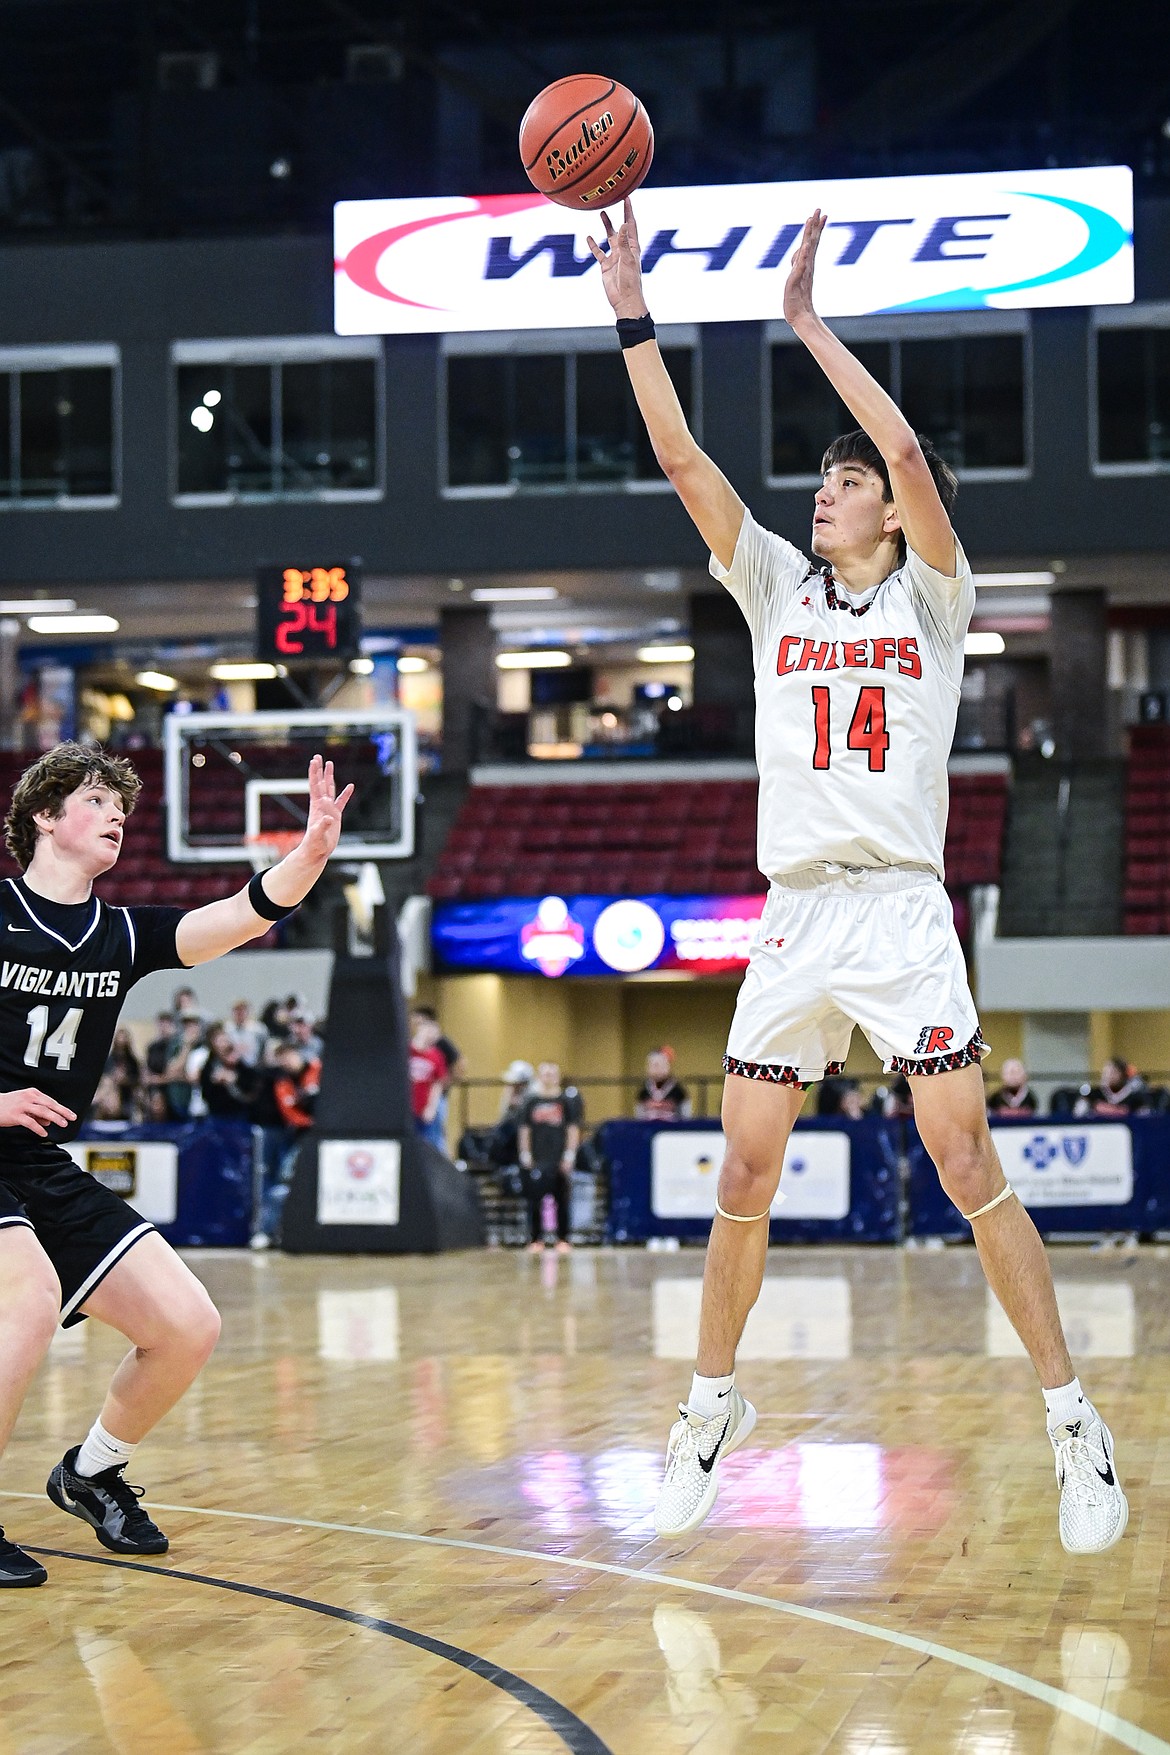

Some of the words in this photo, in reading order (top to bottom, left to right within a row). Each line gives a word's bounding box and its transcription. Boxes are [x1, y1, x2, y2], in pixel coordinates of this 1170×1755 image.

[546, 111, 614, 182] Baden
[566, 133, 610, 177] PERFECTION
[579, 148, 639, 203] ELITE
[483, 213, 1011, 280] WHITE
[283, 567, 350, 603] 3:35
[275, 600, 338, 654] 24
[777, 635, 923, 680] CHIEFS
[811, 685, 890, 772] 14
[0, 960, 121, 998] VIGILANTES
[23, 1004, 85, 1071] 14
[924, 1026, 954, 1053] R
